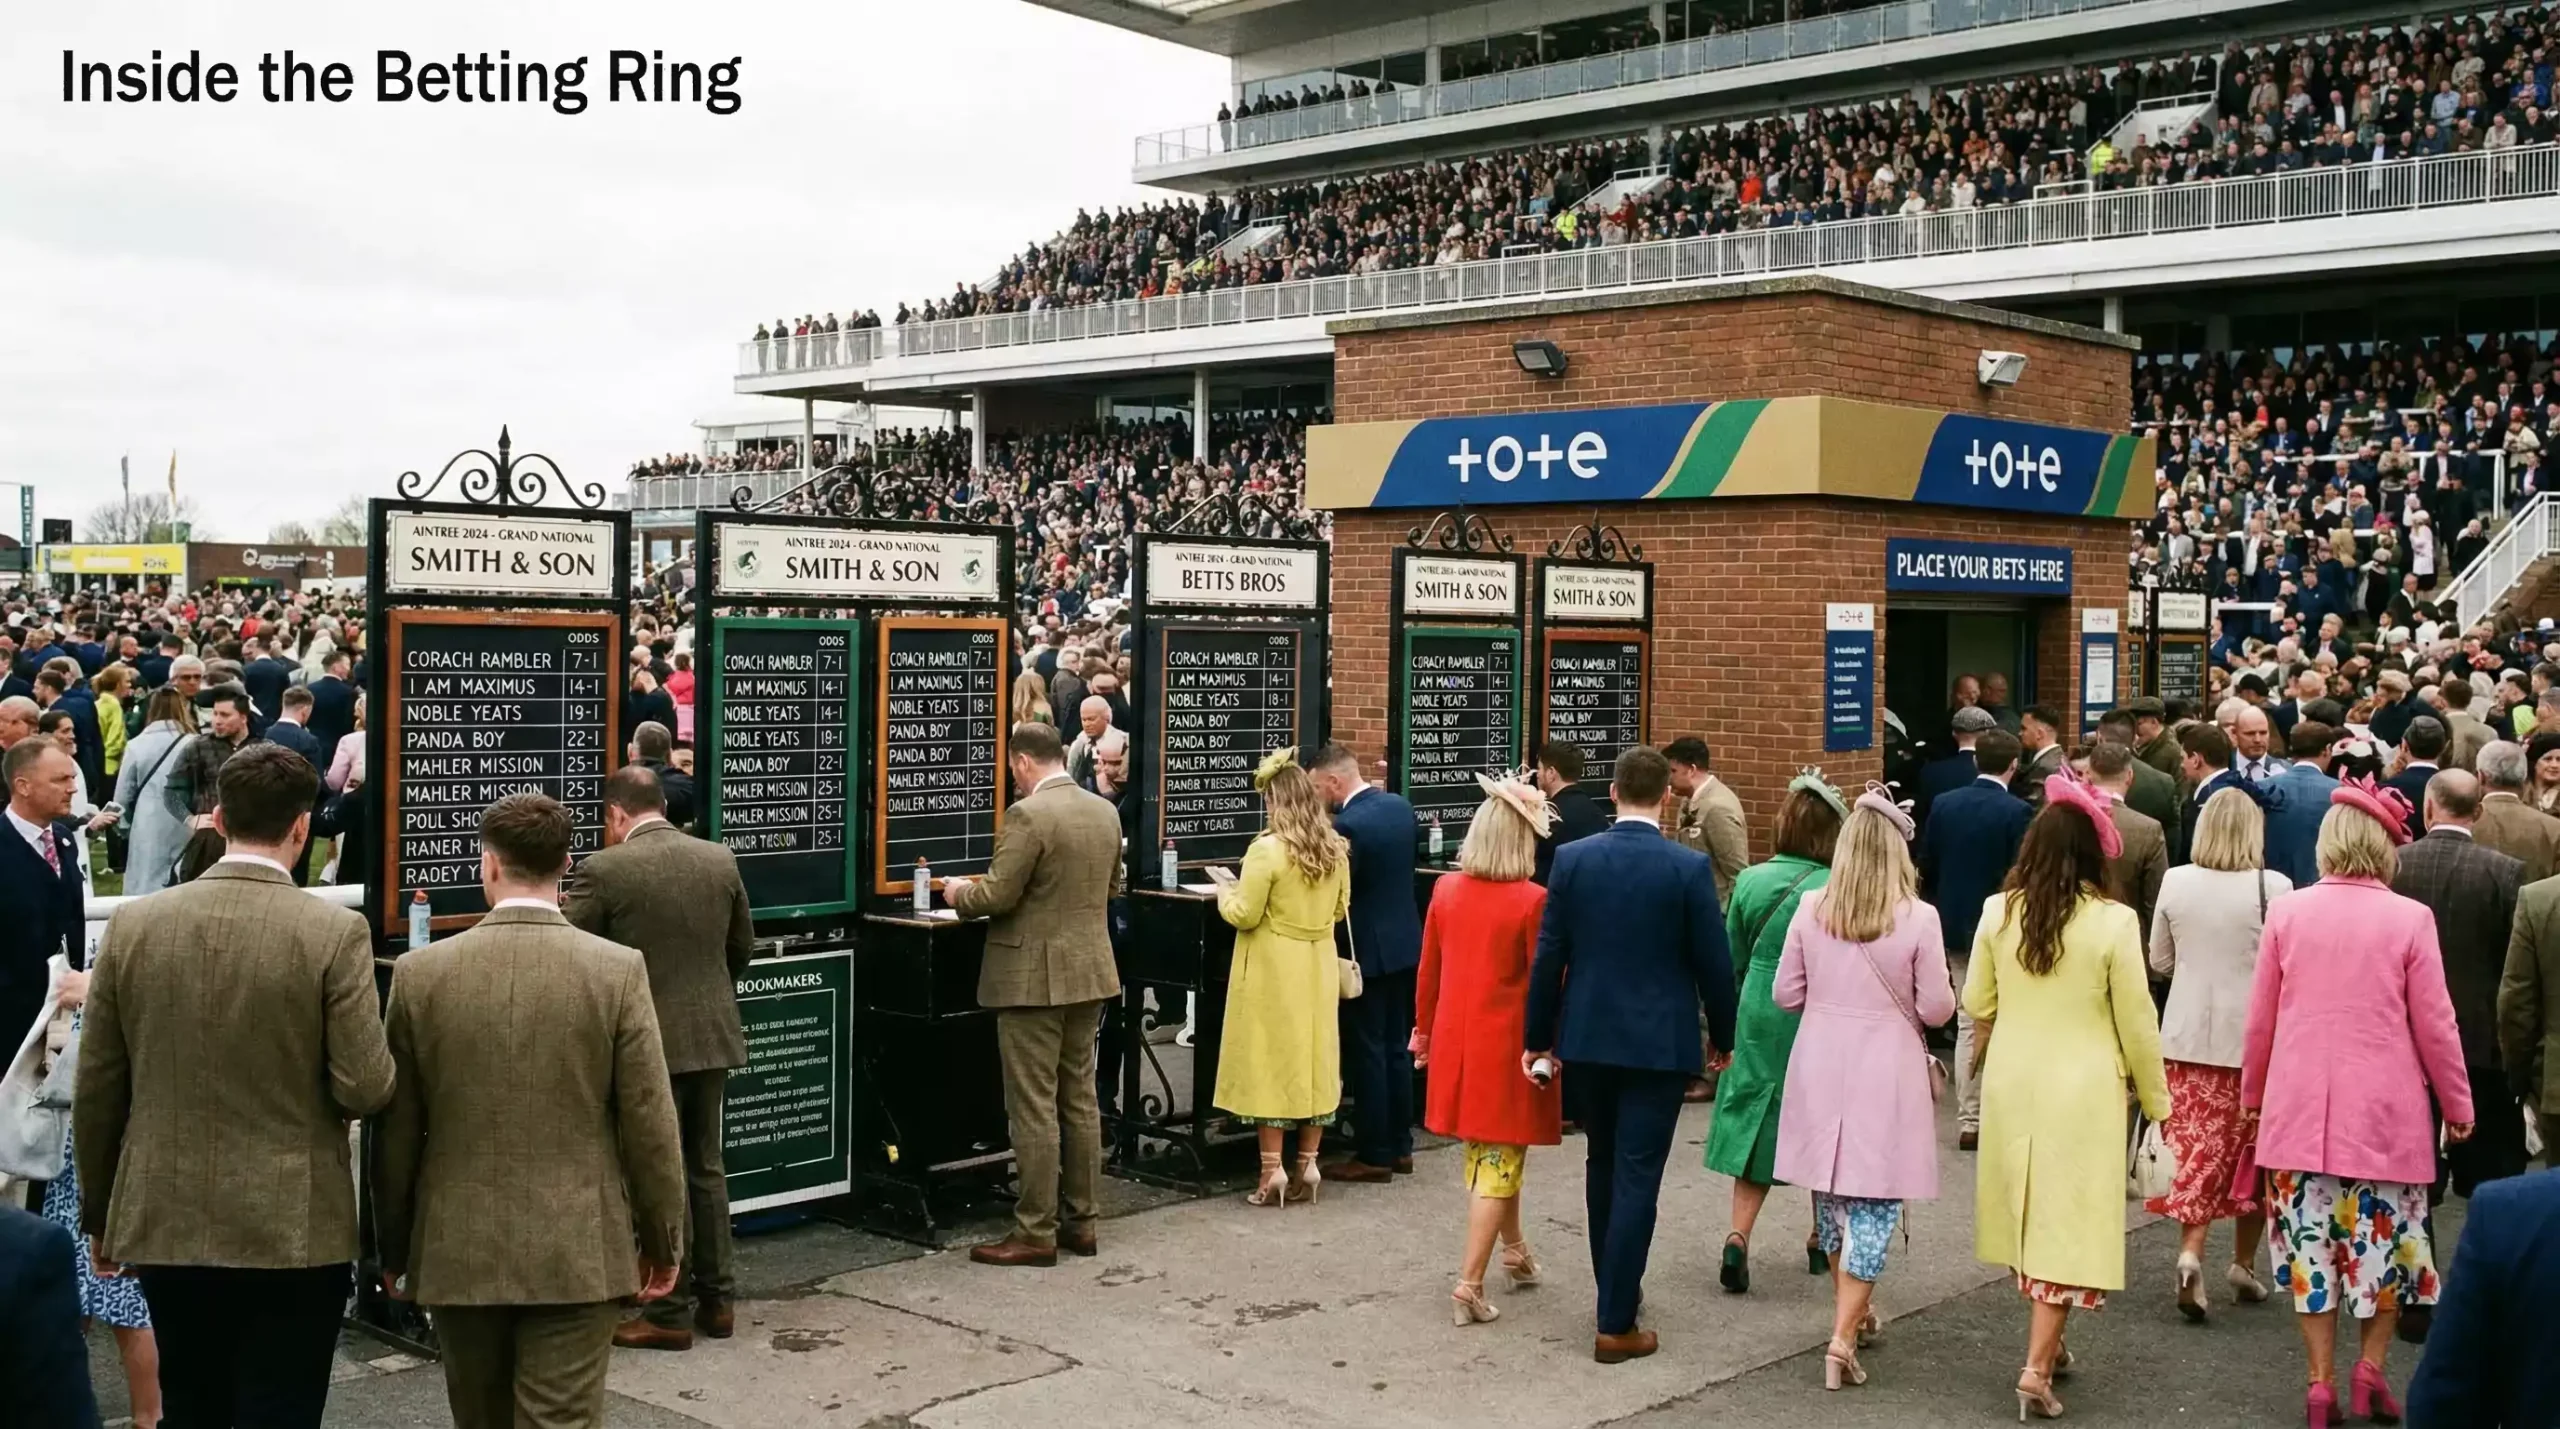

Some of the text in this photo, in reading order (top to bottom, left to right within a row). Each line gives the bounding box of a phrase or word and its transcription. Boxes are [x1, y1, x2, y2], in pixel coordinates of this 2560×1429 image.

[1448, 431, 1607, 483] tote
[1965, 439, 2061, 493] tote
[413, 526, 459, 538] AINTREE
[462, 528, 488, 539] 2024
[498, 529, 538, 541] GRAND
[541, 531, 595, 544] NATIONAL
[785, 537, 826, 549] AINTREE
[859, 540, 893, 551] GRAND
[895, 541, 941, 553] NATIONAL
[411, 547, 595, 576] SMITH & SON
[786, 556, 861, 580] SMITH
[869, 559, 885, 581] &
[892, 560, 939, 582] SON
[1897, 552, 2064, 582] PLACE YOUR BETS HERE
[1182, 569, 1285, 592] BETTS BROS
[1415, 581, 1507, 601] SMITH & SON
[1553, 588, 1636, 607] SMITH & SON
[568, 633, 599, 644] ODDS
[408, 651, 597, 669] CORACH RAMBLER 7-1
[724, 655, 764, 670] CORACH
[823, 655, 842, 670] 7-1
[974, 651, 991, 665] 7-1
[1169, 651, 1287, 665] CORACH RAMBLER 7-1
[425, 678, 450, 695] AM
[461, 678, 536, 695] MAXIMUS
[570, 678, 599, 695] 14-1
[735, 680, 752, 695] AM
[822, 680, 843, 695] 14-1
[897, 676, 913, 690] AM
[974, 675, 993, 689] 14-1
[1179, 673, 1195, 686] AM
[1269, 673, 1288, 686] 14-1
[889, 698, 993, 715] NOBLE YEATS 18-1
[1168, 693, 1288, 707] NOBLE YEATS 18-1
[407, 704, 598, 721] NOBLE YEATS 19-1
[724, 705, 842, 721] NOBLE YEATS 14-1
[1168, 713, 1288, 728] PANDA BOY 22-1
[407, 731, 599, 748] PANDA BOY 22-1
[724, 731, 761, 747] NOBLE
[765, 731, 800, 746] YEATS
[889, 724, 926, 739] PANDA
[930, 723, 951, 738] BOY
[1168, 734, 1288, 749] PANDA BOY 22-1
[889, 748, 926, 763] PANDA
[930, 747, 952, 762] BOY
[1209, 755, 1247, 769] MISSION
[407, 756, 599, 775] MAHLER MISSION 25-1
[723, 755, 842, 773] PANDA BOY 22-1
[928, 771, 964, 786] MISSION
[406, 785, 471, 802] MAHLER
[567, 782, 598, 797] 25-1
[723, 780, 841, 799] MAHLER MISSION 25-1
[927, 793, 993, 810] MISSION 25-1
[406, 812, 446, 829] POUL
[452, 812, 481, 828] SHO
[722, 804, 841, 824] MAHLER MISSION 25-1
[818, 829, 841, 845] 25-1
[406, 866, 461, 884] RADEY
[737, 972, 823, 994] BOOKMAKERS
